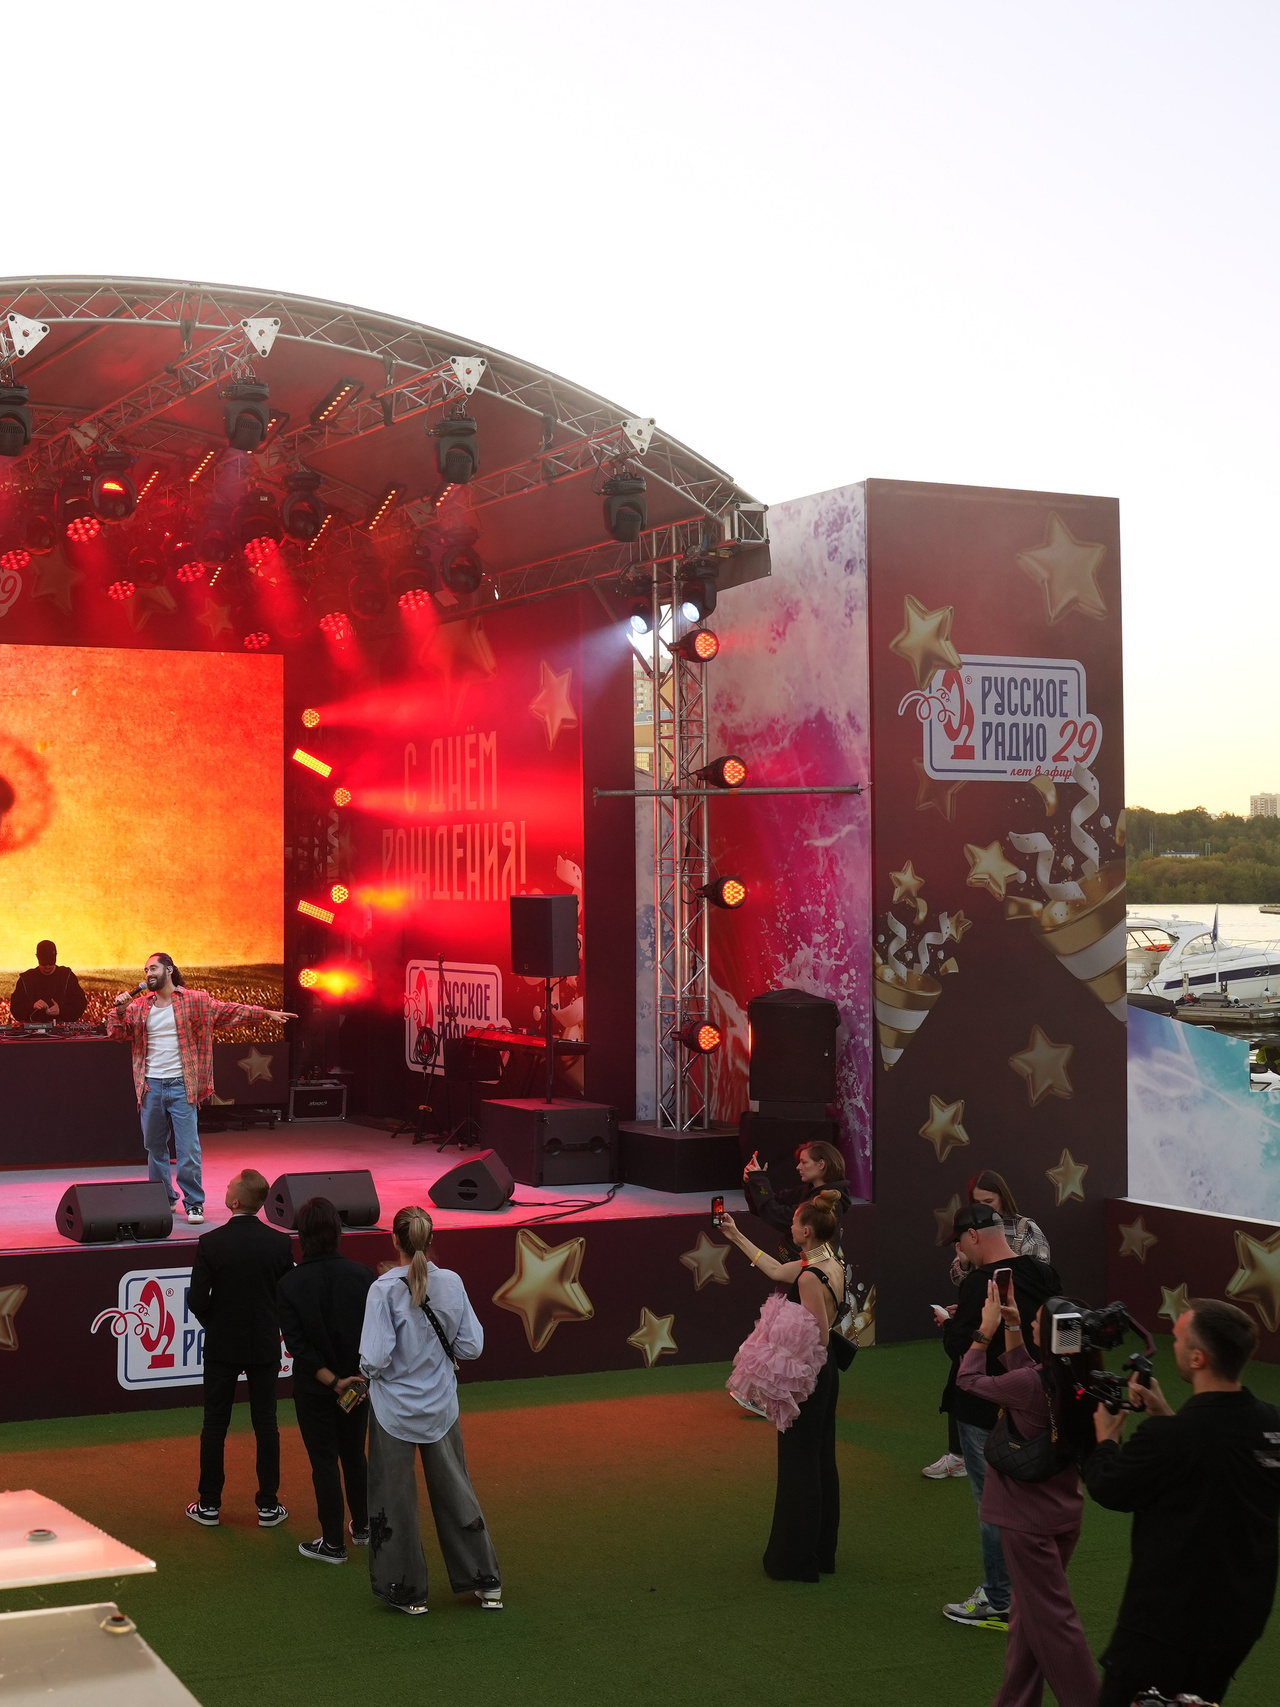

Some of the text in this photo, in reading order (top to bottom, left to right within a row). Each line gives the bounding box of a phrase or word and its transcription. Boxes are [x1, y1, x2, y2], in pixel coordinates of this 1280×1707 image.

[981, 675, 1069, 718] РУССКОЕ
[981, 719, 1098, 763] РАДИО 29
[404, 725, 498, 815] С ДНЁМ
[1010, 768, 1033, 777] лет
[1044, 763, 1074, 782] эфир
[382, 820, 527, 902] РОЖДЕНИЯ!
